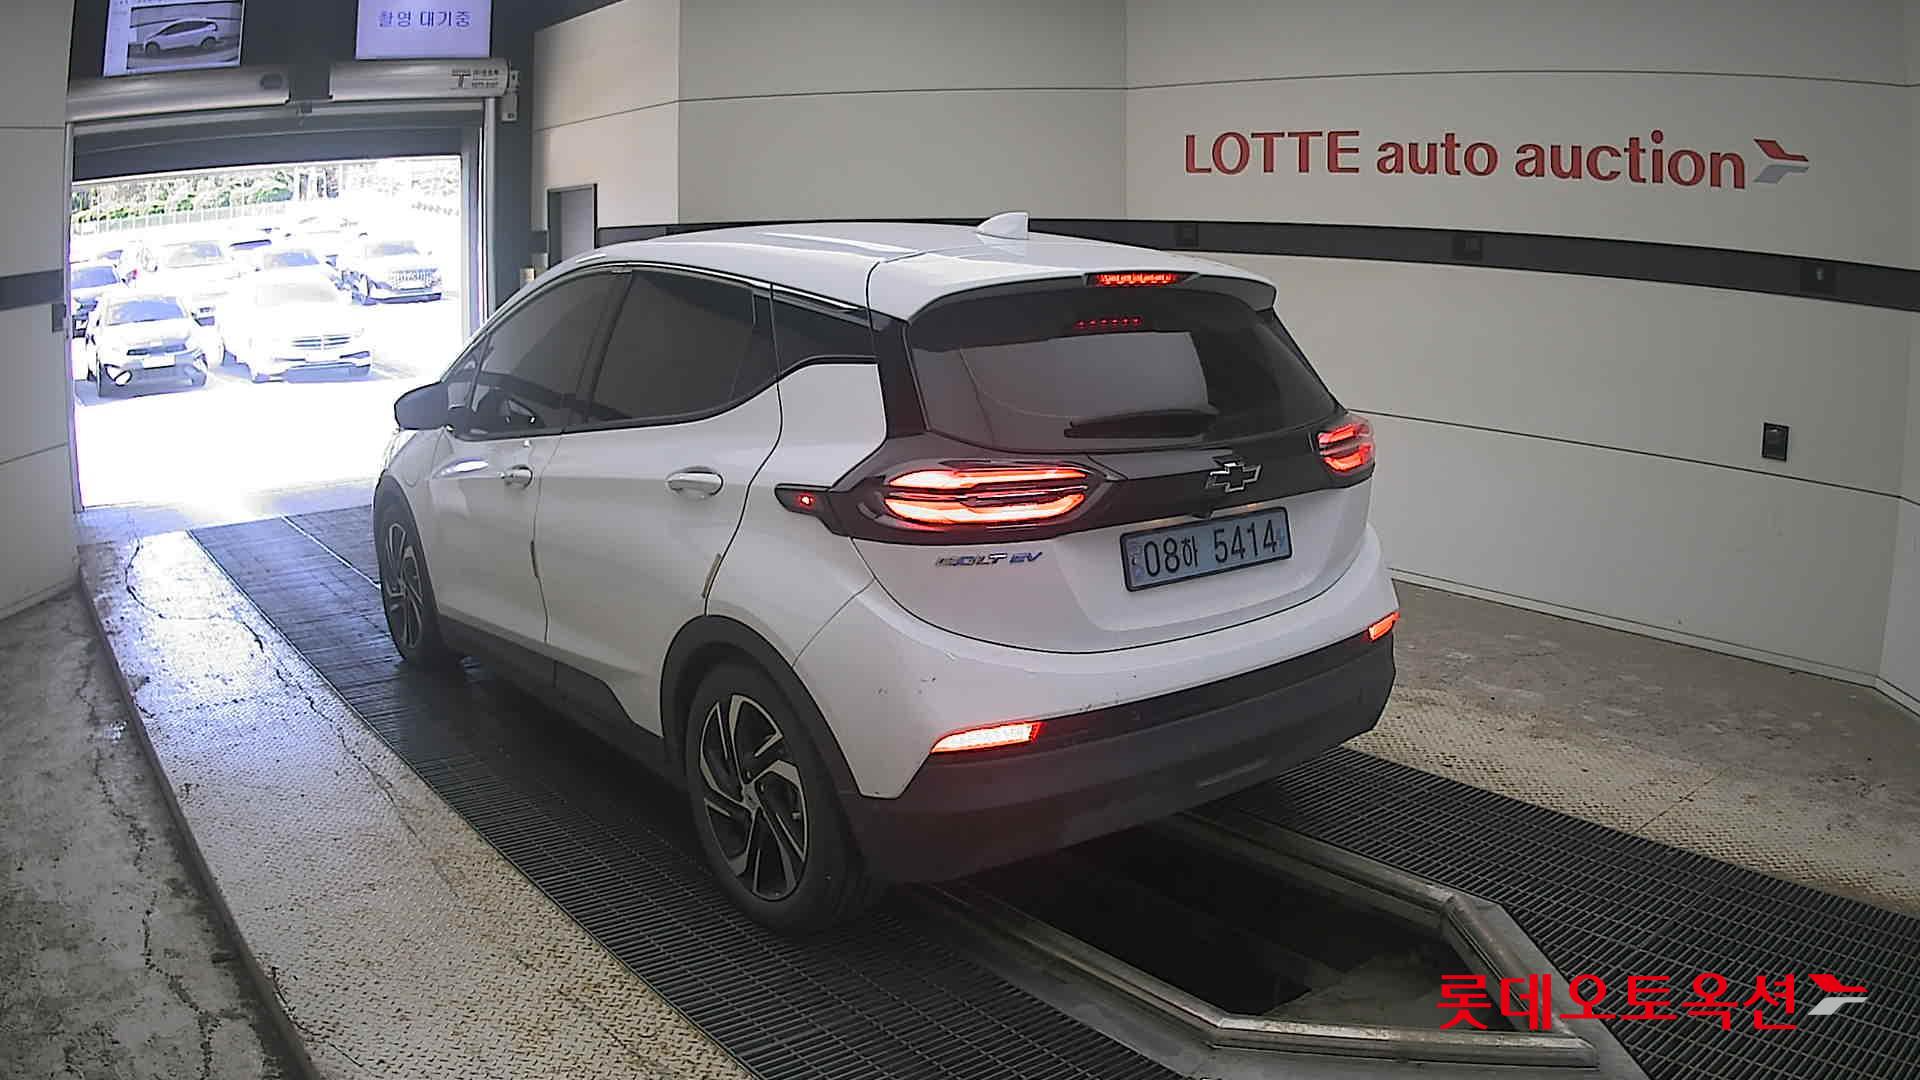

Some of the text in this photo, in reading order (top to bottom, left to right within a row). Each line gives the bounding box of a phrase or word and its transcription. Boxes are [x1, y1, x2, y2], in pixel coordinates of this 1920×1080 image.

[420, 10, 471, 28] 대기중
[1185, 129, 1745, 189] LOTTE auto auction
[1009, 551, 1042, 564] EV
[1143, 519, 1278, 577] 08하 5414
